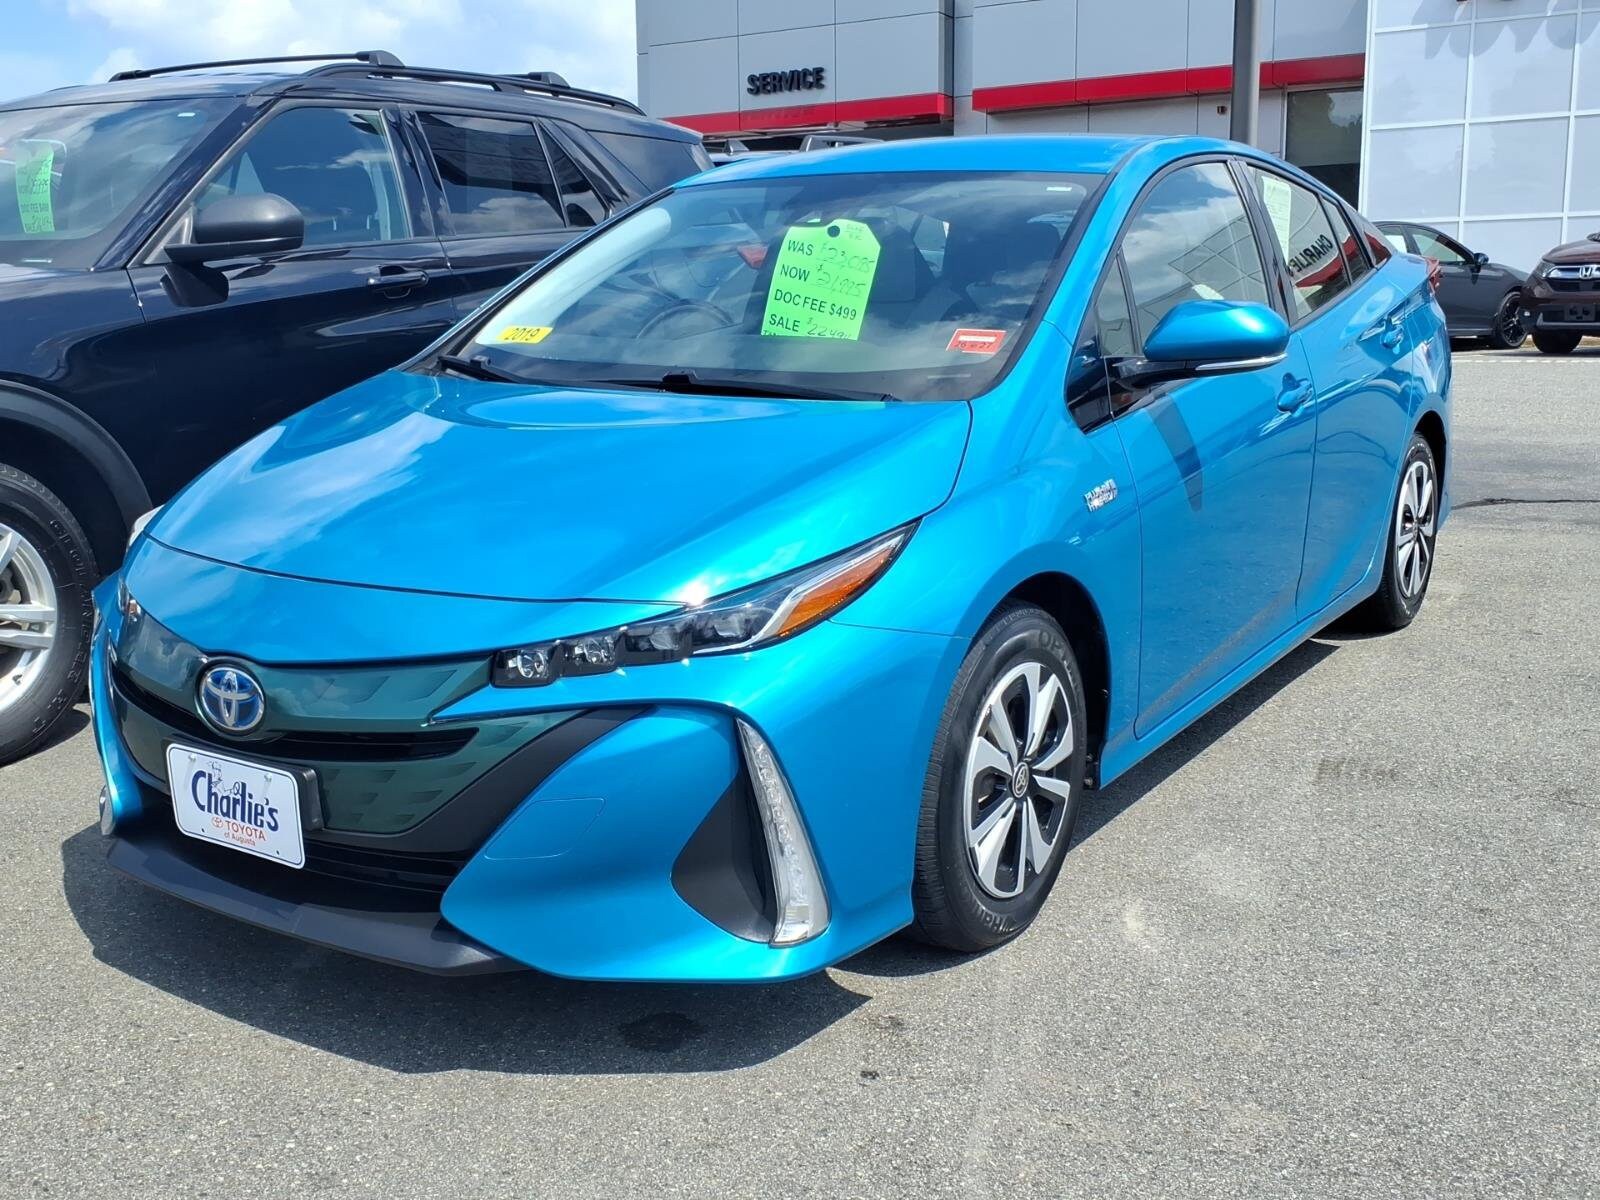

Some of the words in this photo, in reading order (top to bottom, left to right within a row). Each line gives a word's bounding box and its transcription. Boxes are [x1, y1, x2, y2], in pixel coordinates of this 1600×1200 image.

[747, 67, 825, 95] SERVICE
[787, 240, 814, 256] WAS
[780, 264, 810, 282] NOW
[774, 289, 800, 305] DOC
[802, 297, 827, 313] FEE
[829, 303, 857, 321] $499
[769, 314, 800, 332] SALE
[504, 328, 540, 341] 2019
[191, 769, 279, 832] Charlie's
[225, 820, 266, 841] TOYOTA
[232, 833, 256, 846] Augusta
